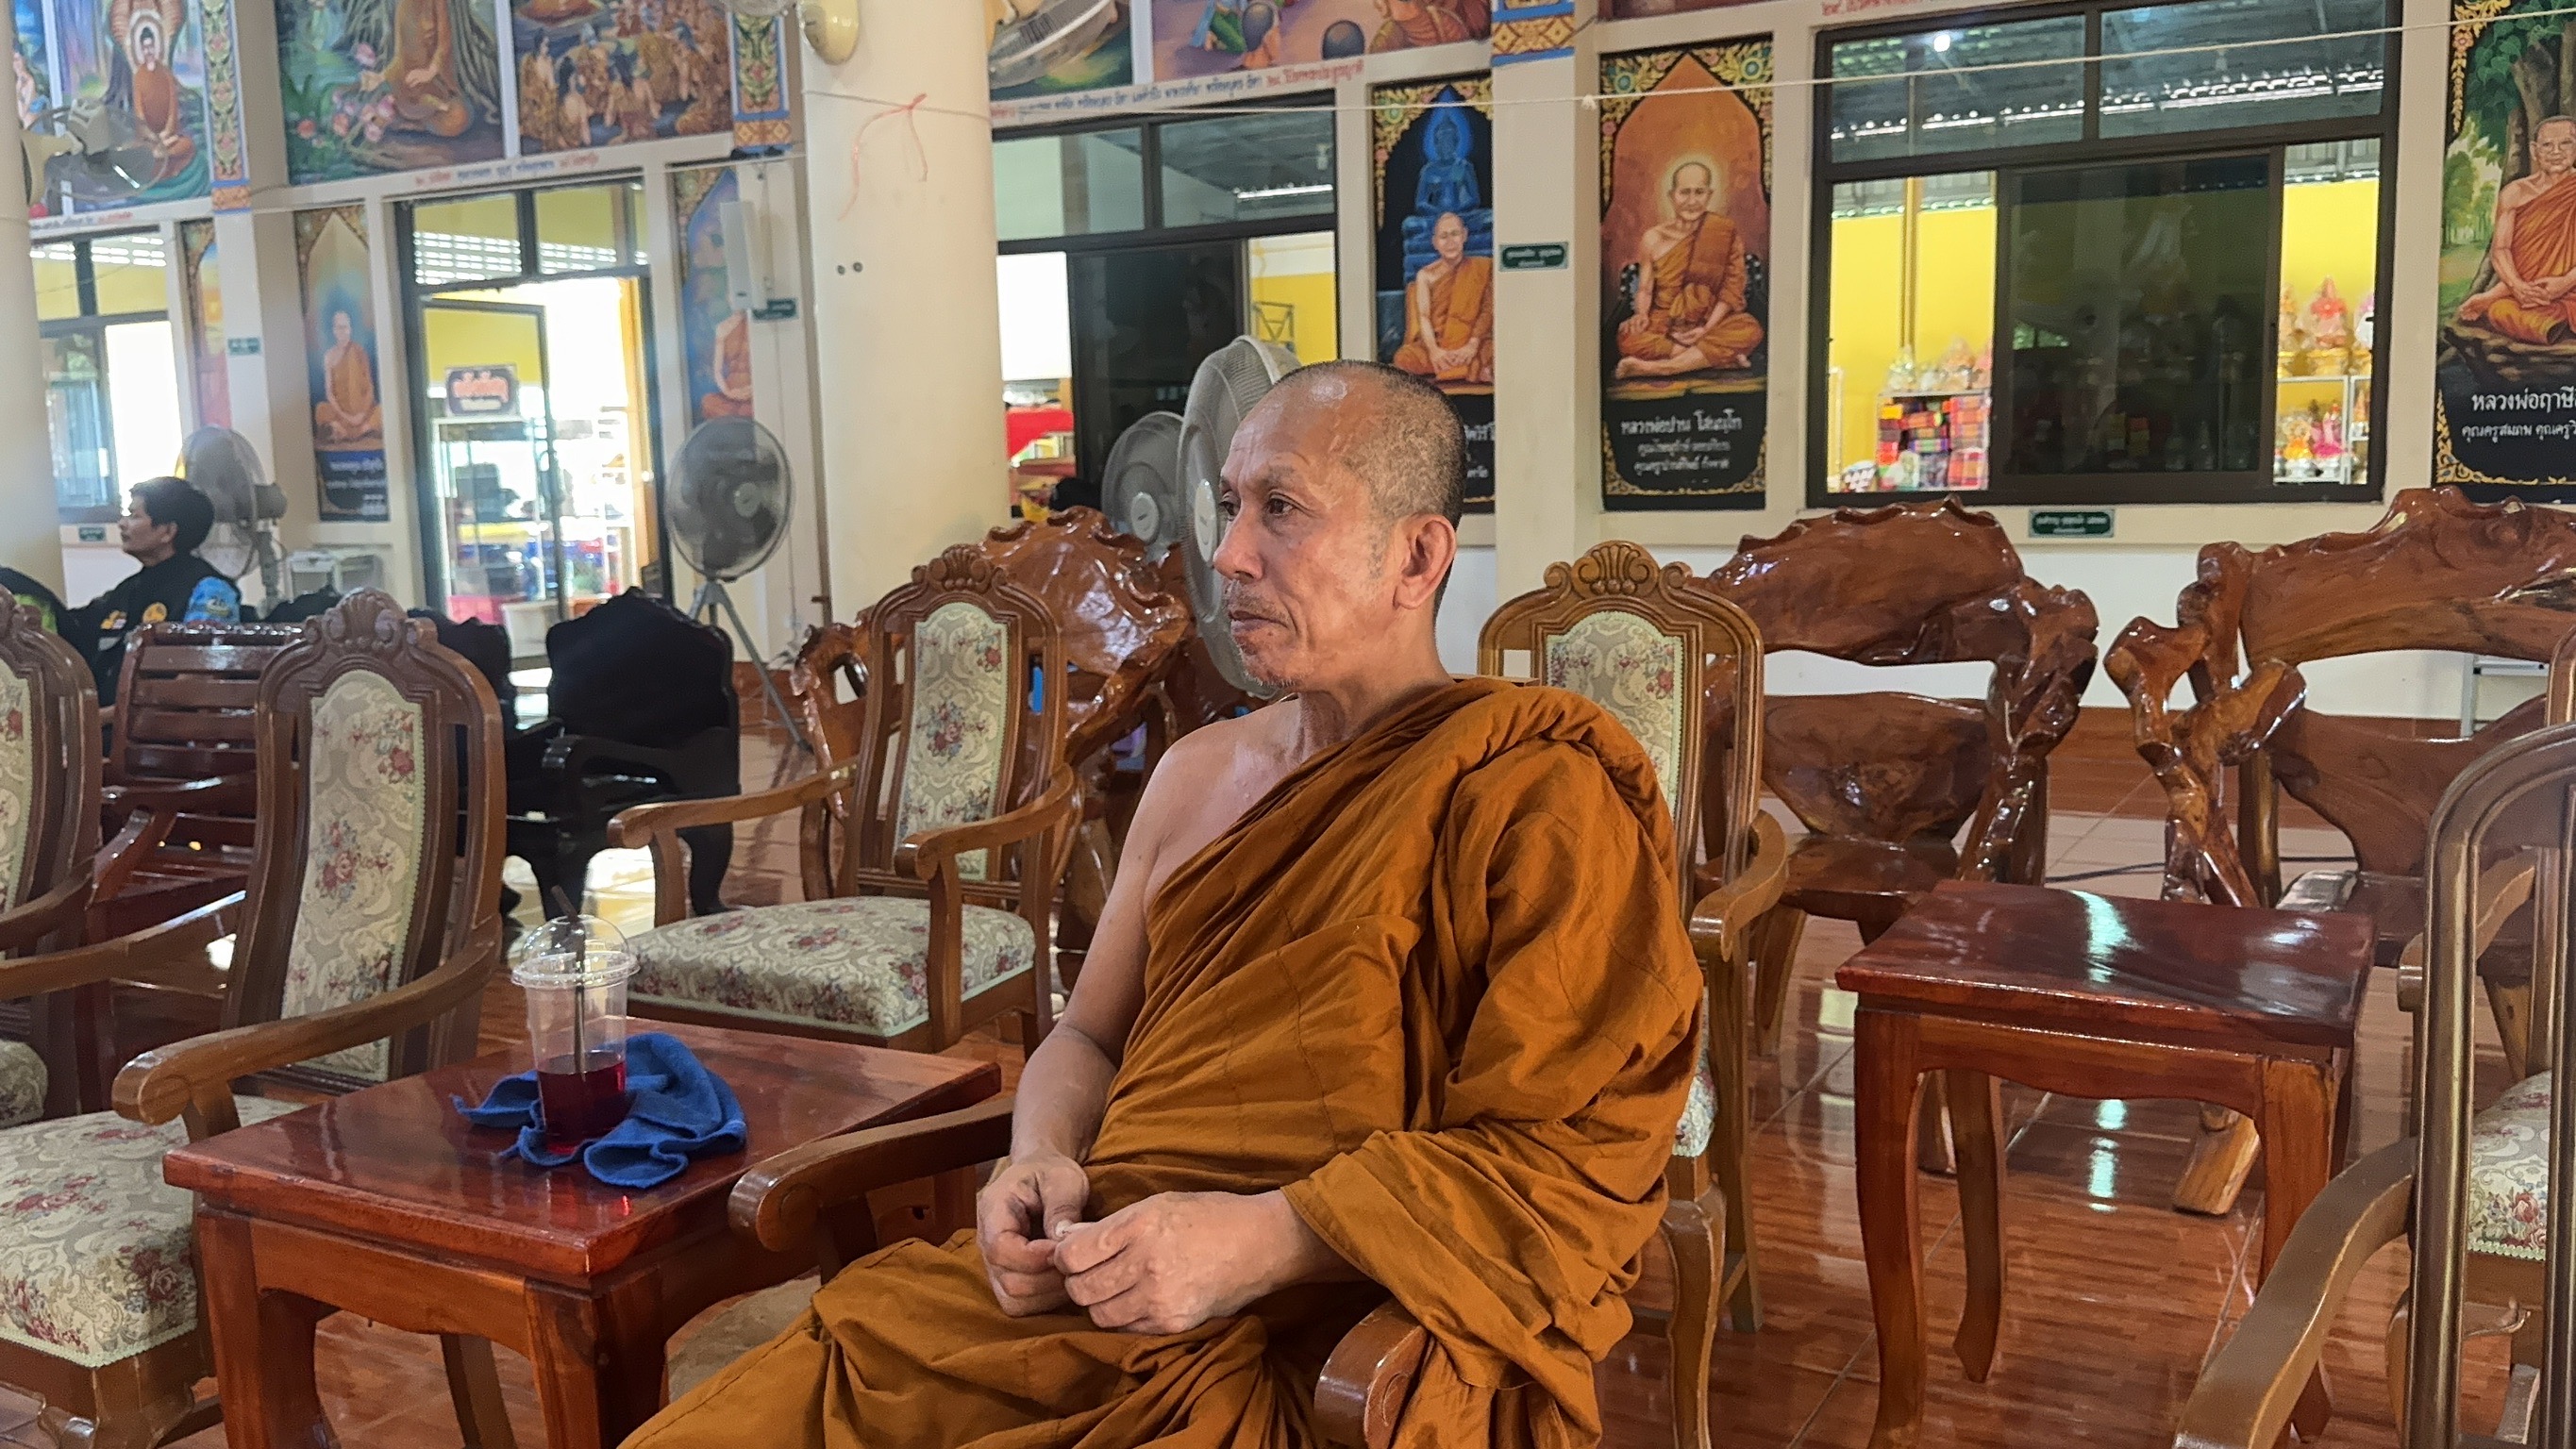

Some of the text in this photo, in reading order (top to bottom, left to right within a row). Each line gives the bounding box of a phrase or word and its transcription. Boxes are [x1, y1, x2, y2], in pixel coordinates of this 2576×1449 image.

[2471, 385, 2576, 413] หลวงพ่อฤาษี
